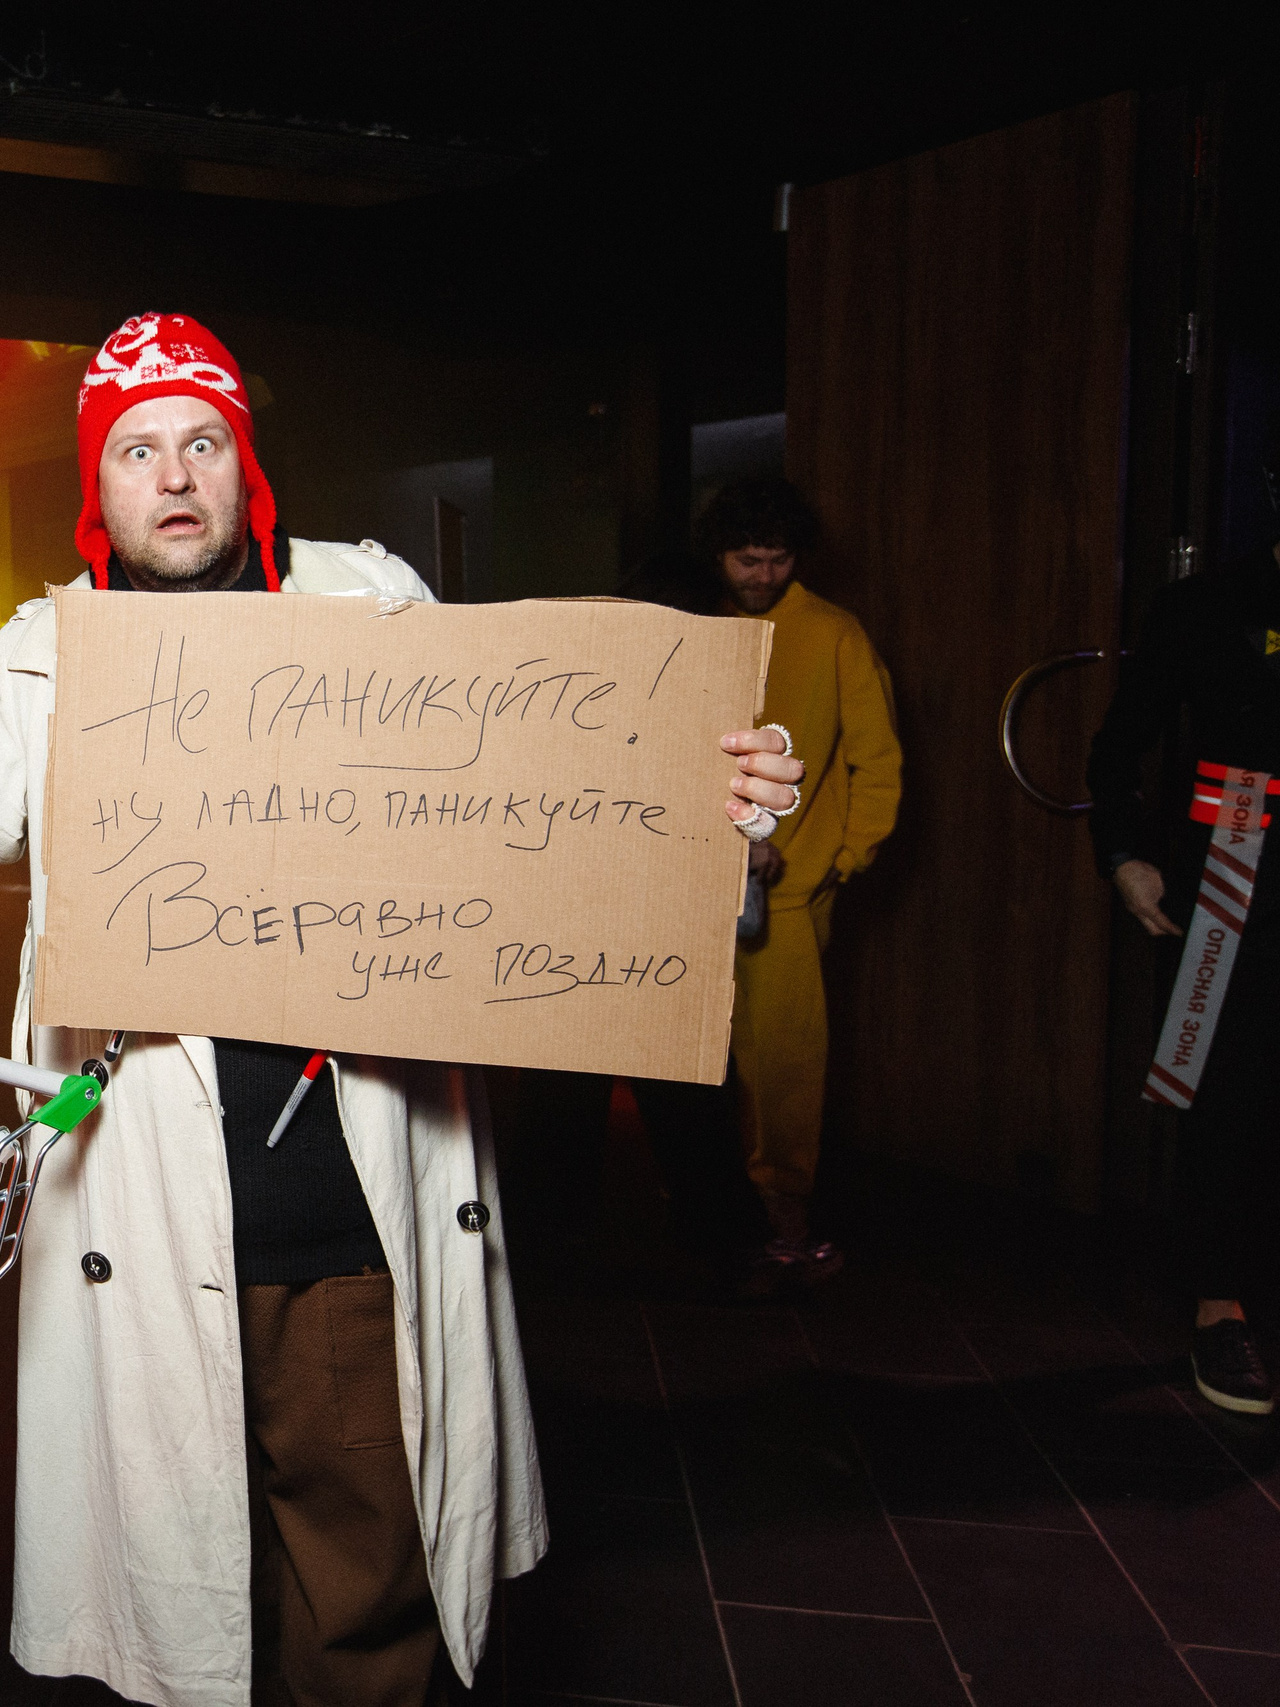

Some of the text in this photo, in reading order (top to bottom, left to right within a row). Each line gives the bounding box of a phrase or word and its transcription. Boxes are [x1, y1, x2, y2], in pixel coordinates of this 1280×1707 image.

[1228, 795, 1252, 846] ЗОНА
[1171, 928, 1226, 1067] ОПАСНАЯ ЗОНА
